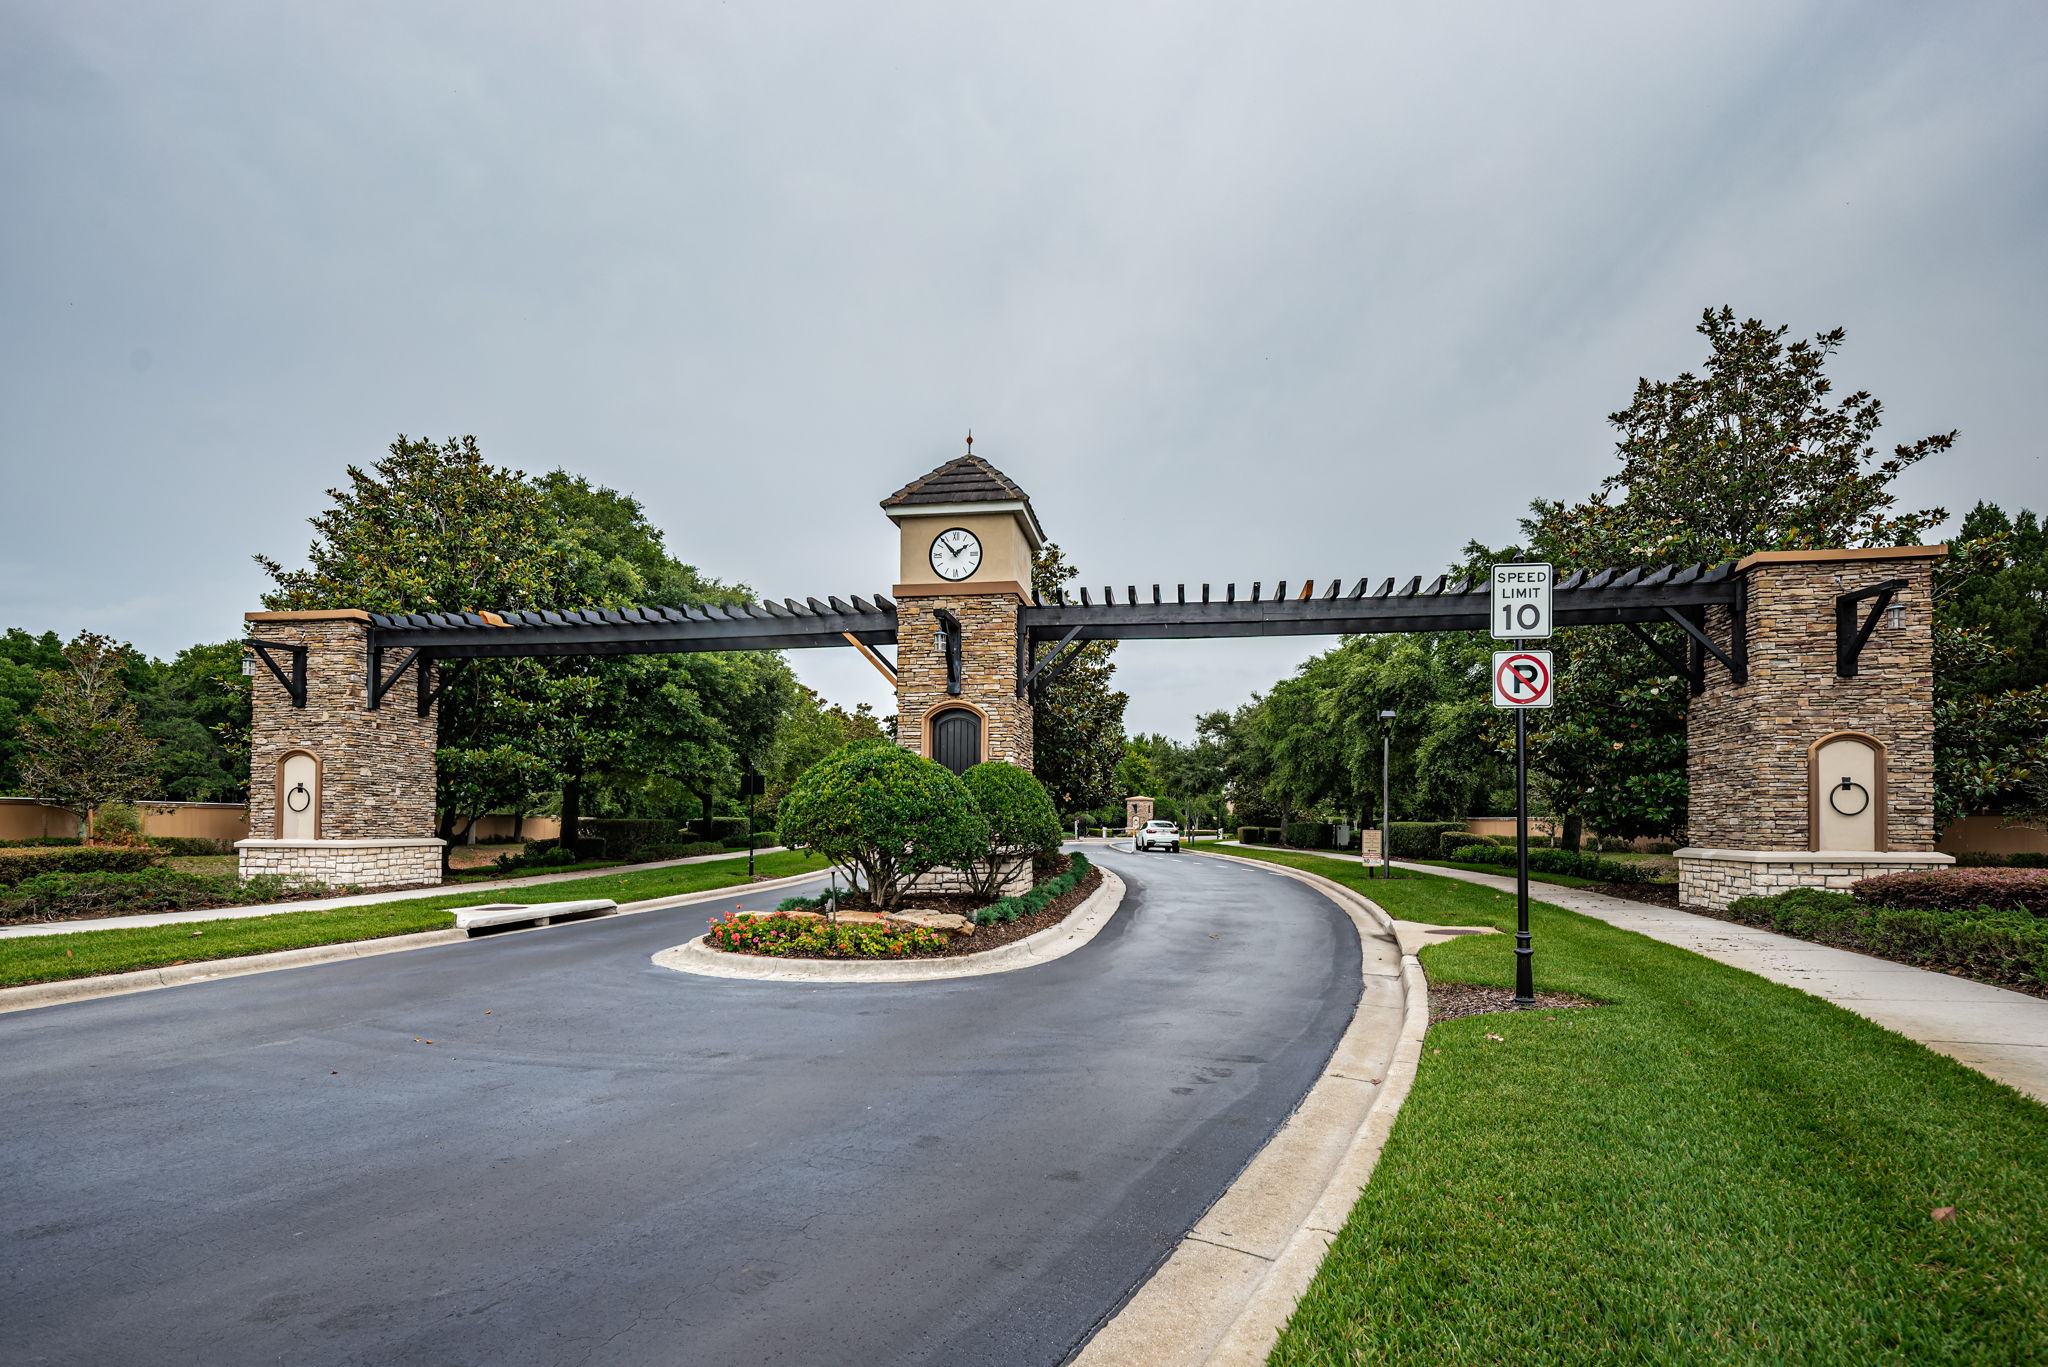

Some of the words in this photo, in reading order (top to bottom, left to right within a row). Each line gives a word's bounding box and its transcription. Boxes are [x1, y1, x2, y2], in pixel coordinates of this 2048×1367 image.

[1497, 572, 1547, 583] SPEED
[1502, 587, 1541, 599] LIMIT
[1502, 603, 1541, 631] 10
[1513, 664, 1539, 694] P
